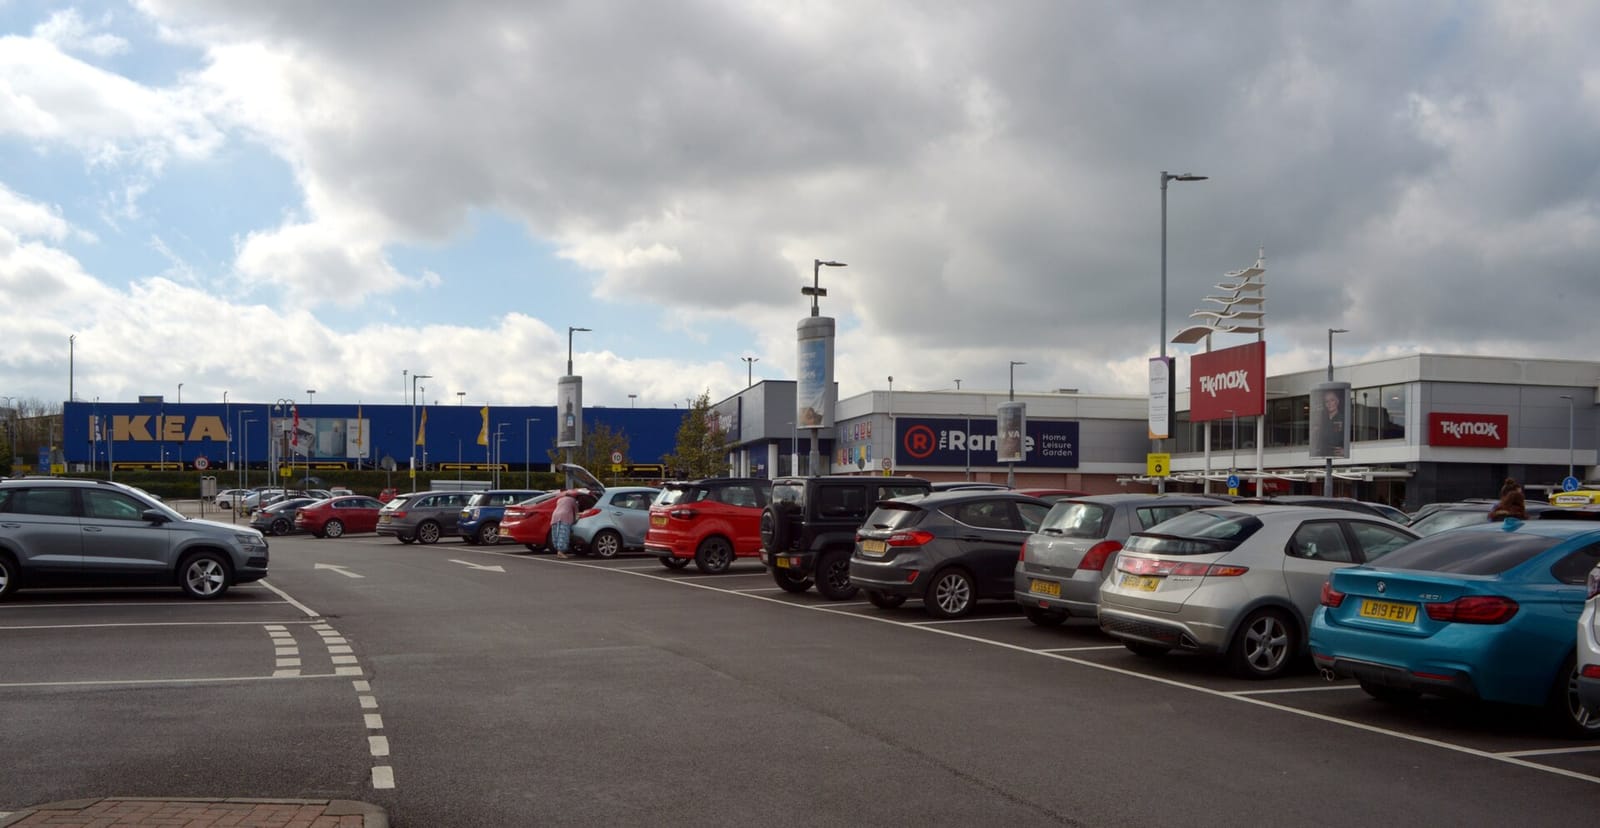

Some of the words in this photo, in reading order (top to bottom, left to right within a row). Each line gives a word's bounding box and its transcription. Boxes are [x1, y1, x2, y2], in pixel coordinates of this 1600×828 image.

[939, 430, 948, 450] The
[949, 430, 1035, 451] Rane
[1042, 433, 1066, 441] Home
[1042, 441, 1072, 449] Leisure
[1364, 601, 1388, 617] LB19
[1389, 604, 1413, 620] FBV
